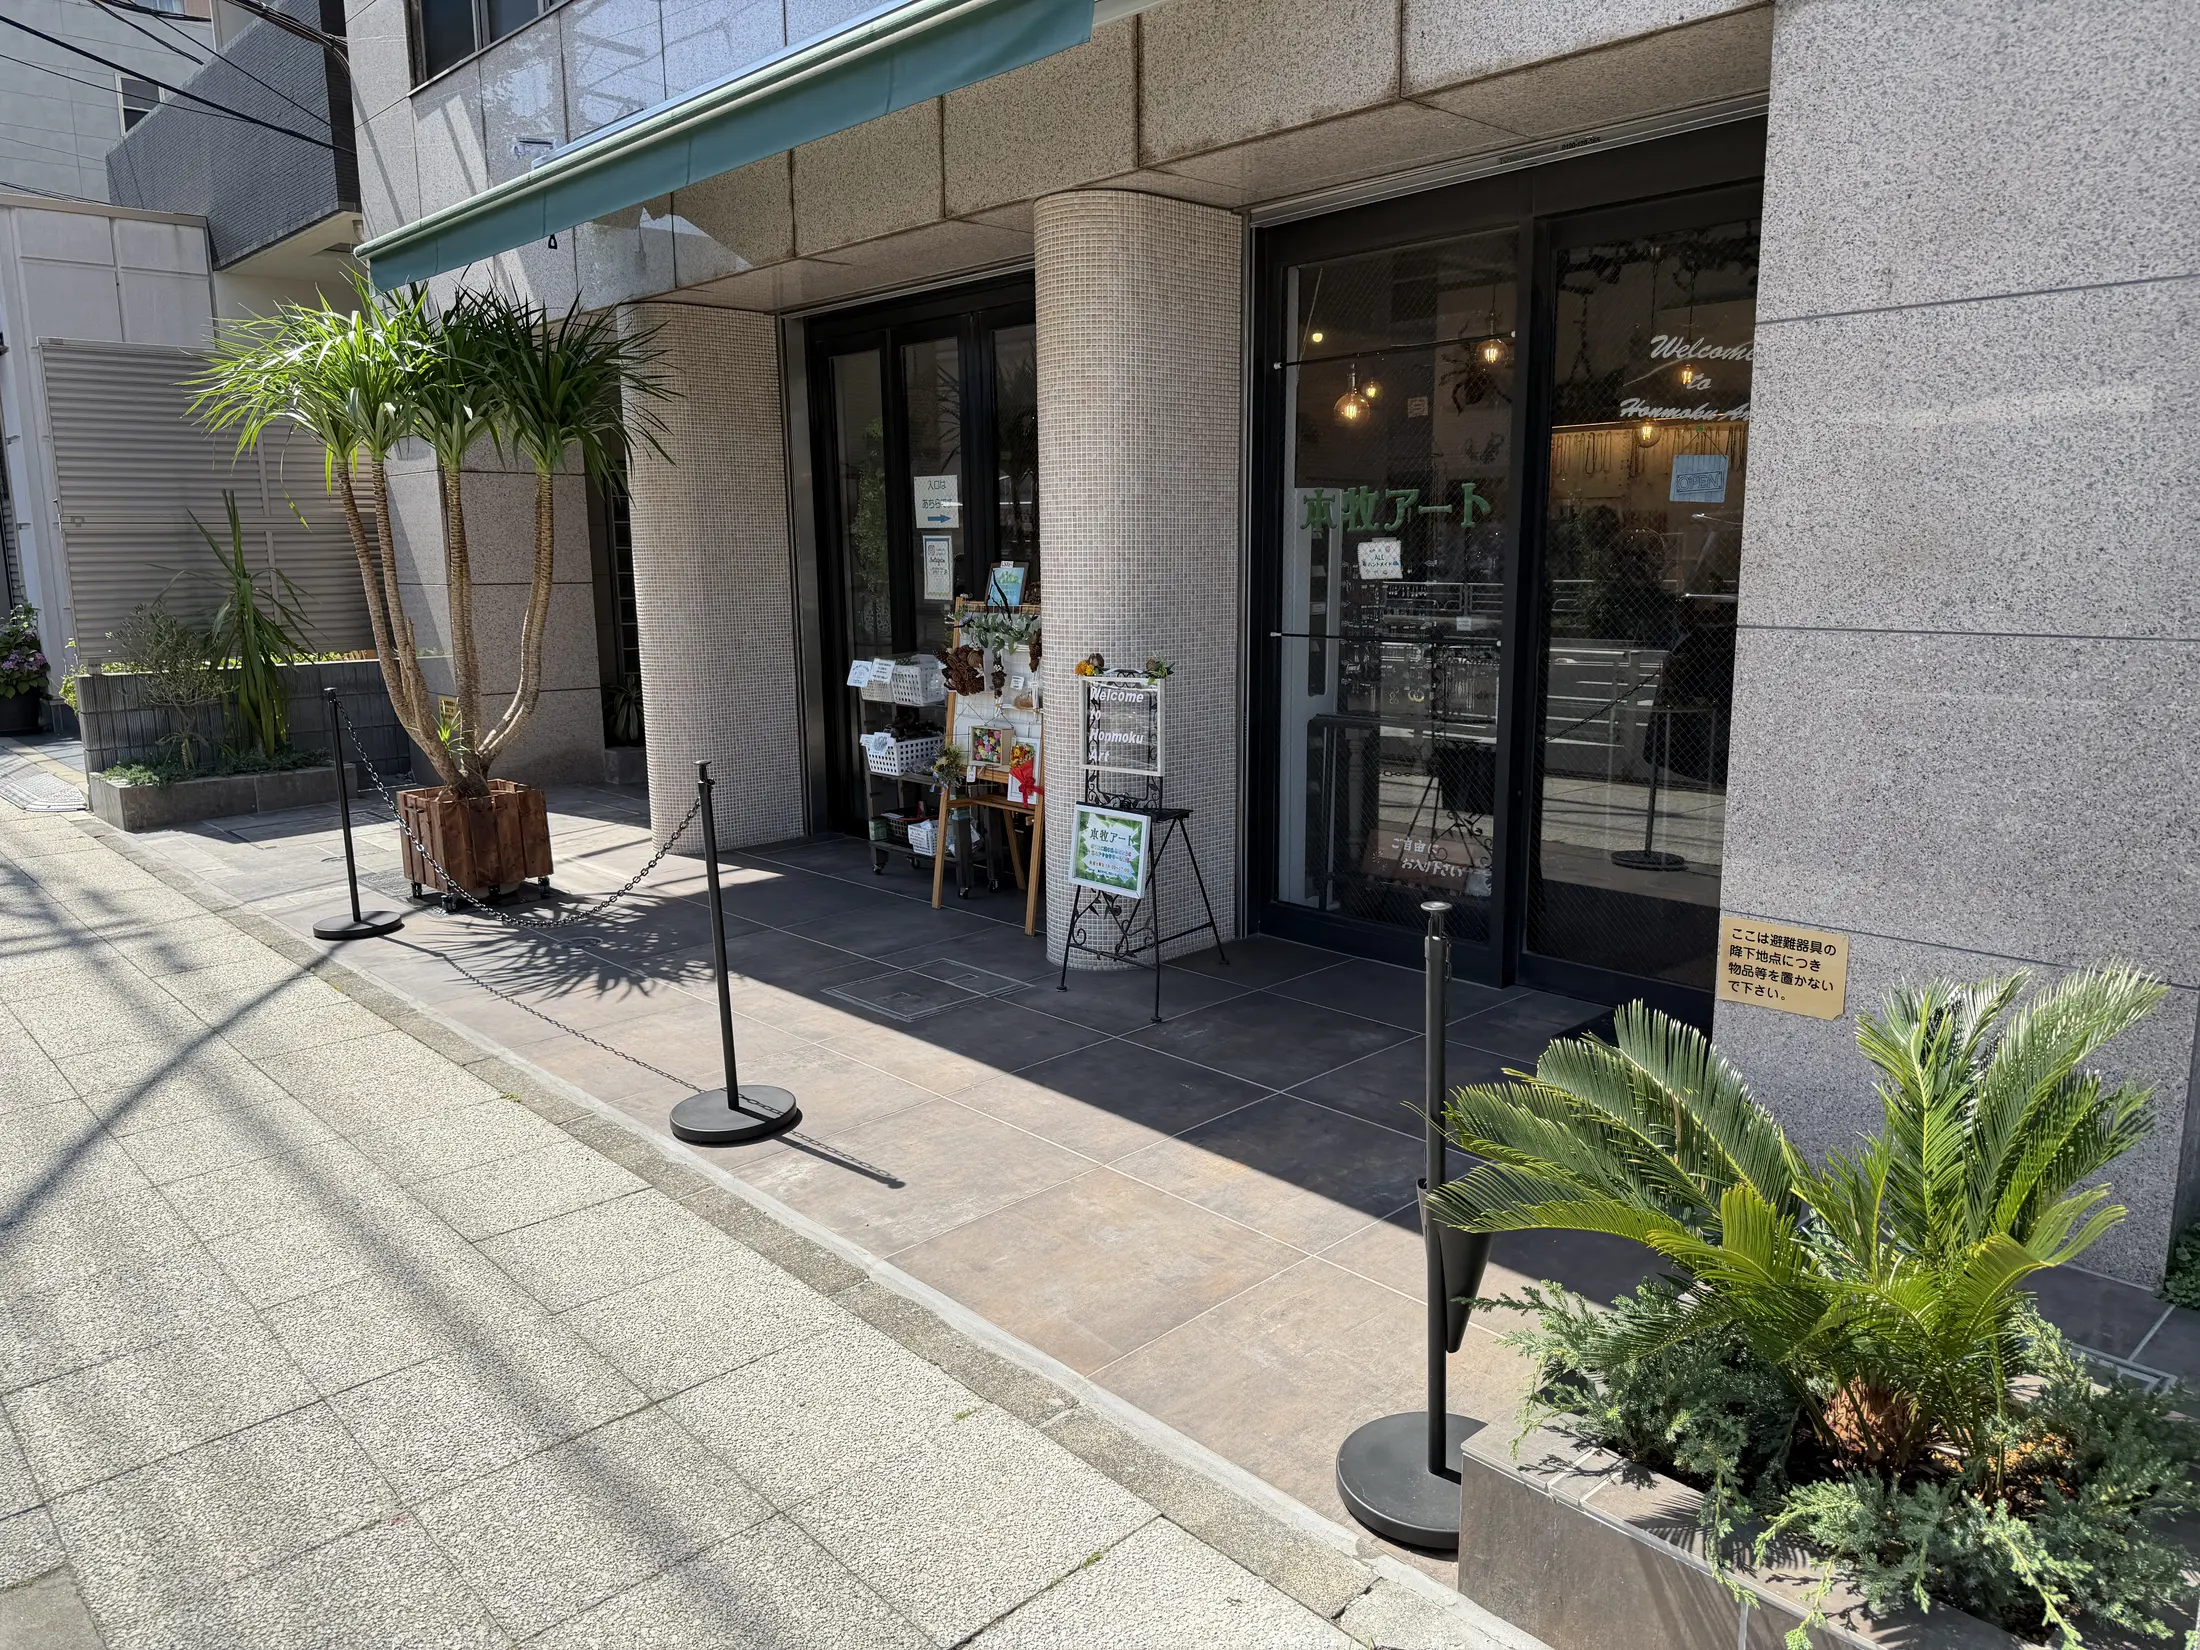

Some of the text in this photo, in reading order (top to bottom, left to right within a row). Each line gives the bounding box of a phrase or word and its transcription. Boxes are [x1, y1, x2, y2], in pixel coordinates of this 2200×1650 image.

[1650, 334, 1755, 361] Welcome
[1686, 373, 1712, 390] to
[1619, 397, 1751, 422] Honmoku Ar
[927, 480, 947, 490] 入口は
[1678, 473, 1720, 491] OPEN
[1300, 482, 1492, 533] 本牧アート
[1089, 686, 1144, 702] Welcome
[1089, 708, 1101, 720] to
[1089, 728, 1144, 744] Honmoku
[1088, 747, 1110, 762] Art
[1089, 827, 1136, 847] 本牧アート
[1391, 837, 1439, 854] ご自由に
[1401, 857, 1463, 878] お入り下さい
[1732, 927, 1837, 956] ここは避難器具の
[1729, 944, 1821, 972] 降下地点につき
[1728, 961, 1834, 991] 物品等を置かない
[1728, 980, 1786, 1001] で下さい。
